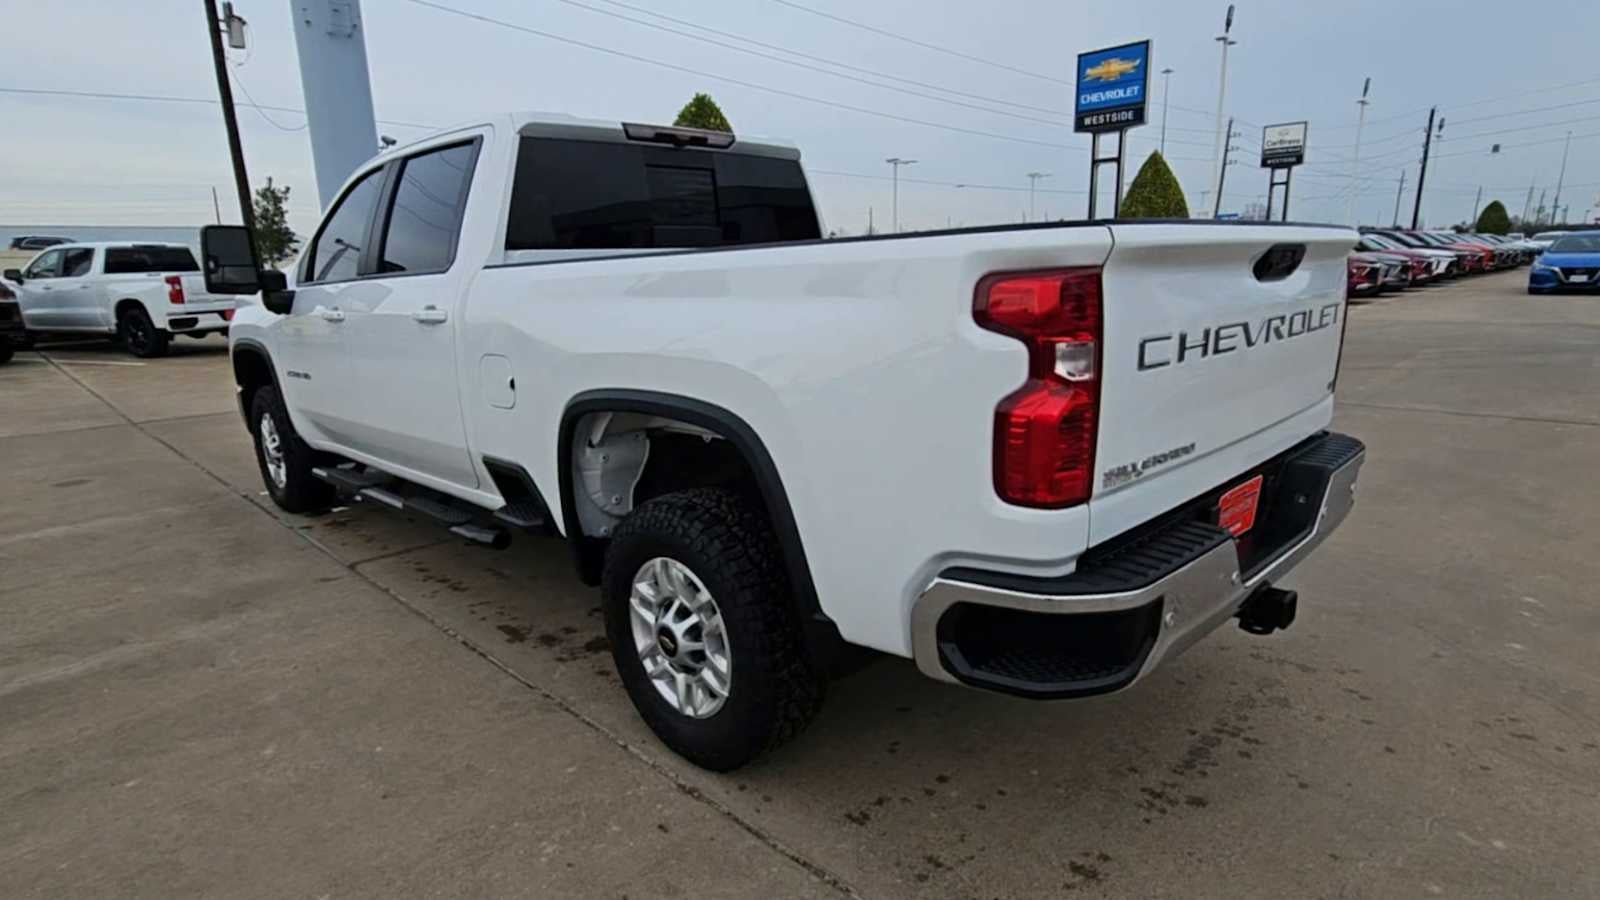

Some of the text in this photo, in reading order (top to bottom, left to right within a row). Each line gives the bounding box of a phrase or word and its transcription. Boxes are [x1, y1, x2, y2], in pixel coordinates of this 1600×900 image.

[1081, 86, 1140, 104] CHEVROLET
[1084, 110, 1134, 126] WESTSIDE
[1137, 303, 1341, 371] CHEVROLET
